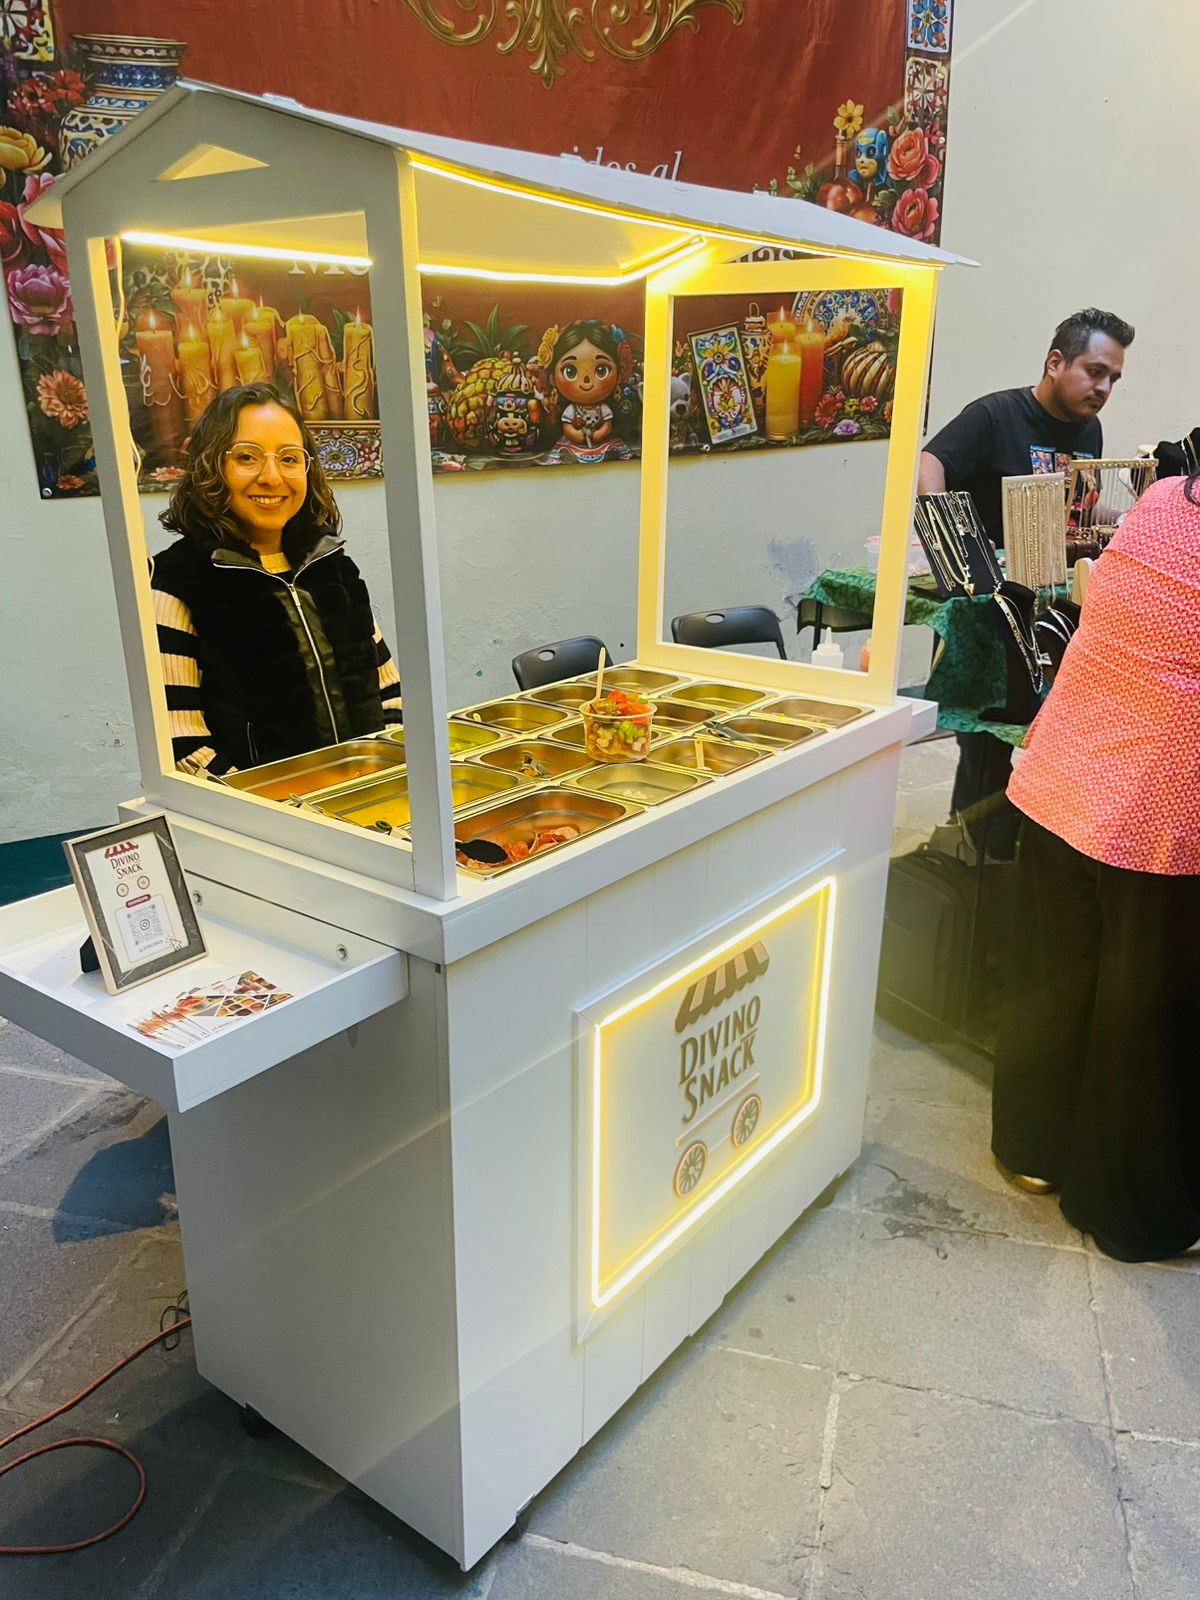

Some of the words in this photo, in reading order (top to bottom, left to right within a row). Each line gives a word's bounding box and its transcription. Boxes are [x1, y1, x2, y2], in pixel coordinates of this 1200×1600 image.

[110, 852, 140, 870] DIVINO
[116, 863, 143, 880] SNACK
[678, 995, 761, 1084] DIVINO
[681, 1034, 756, 1124] SNACK
